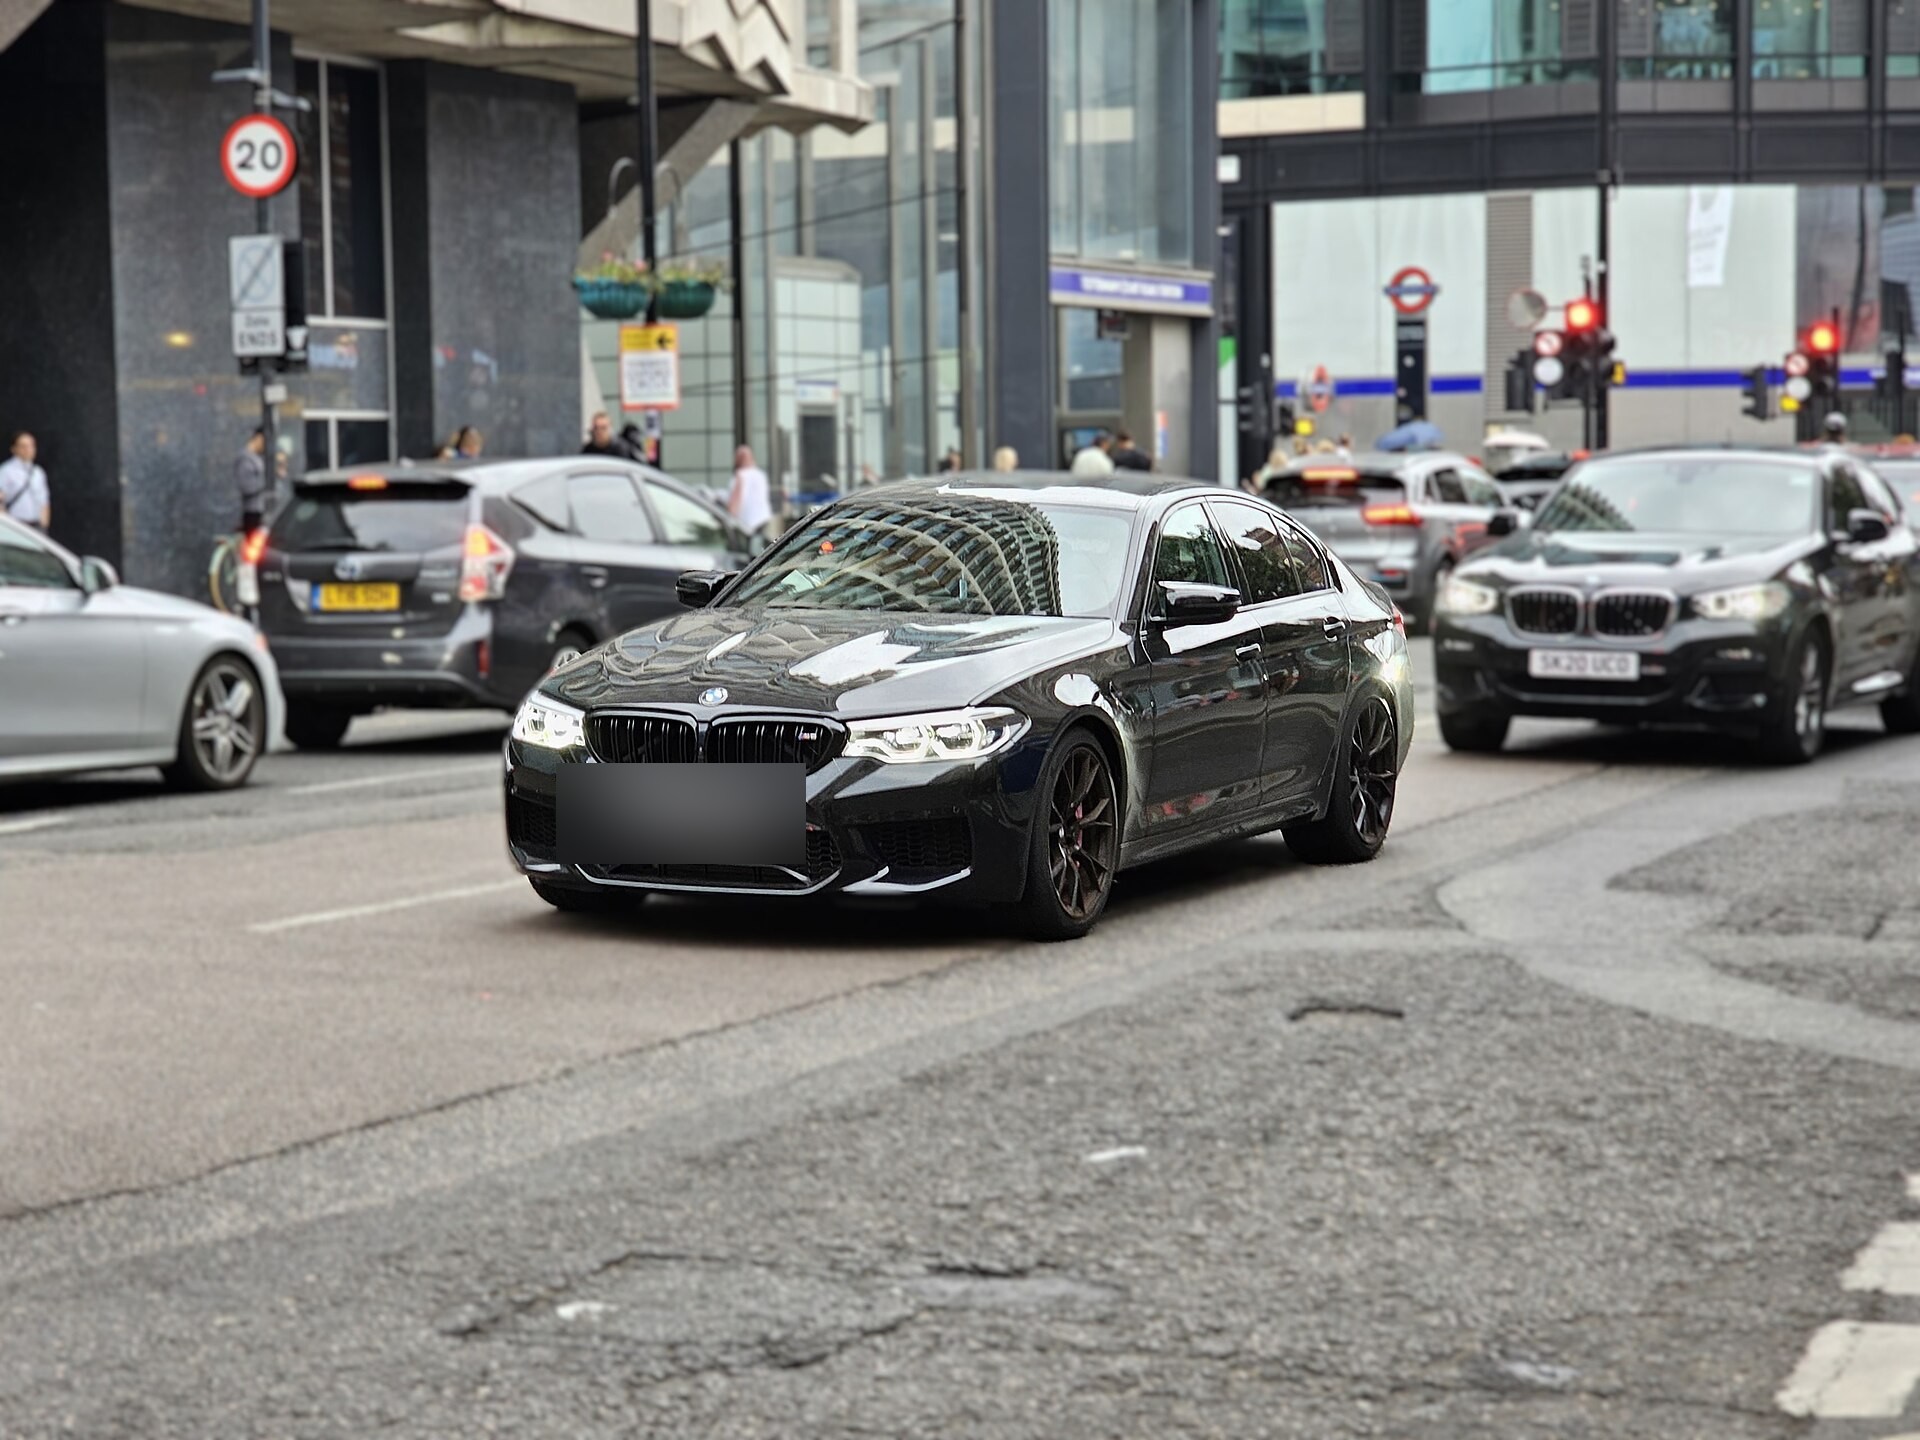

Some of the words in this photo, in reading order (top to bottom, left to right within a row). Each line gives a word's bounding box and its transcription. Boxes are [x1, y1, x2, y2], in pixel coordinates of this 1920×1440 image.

[236, 139, 282, 171] 20
[239, 331, 277, 348] ENDS
[1541, 654, 1588, 673] SK20
